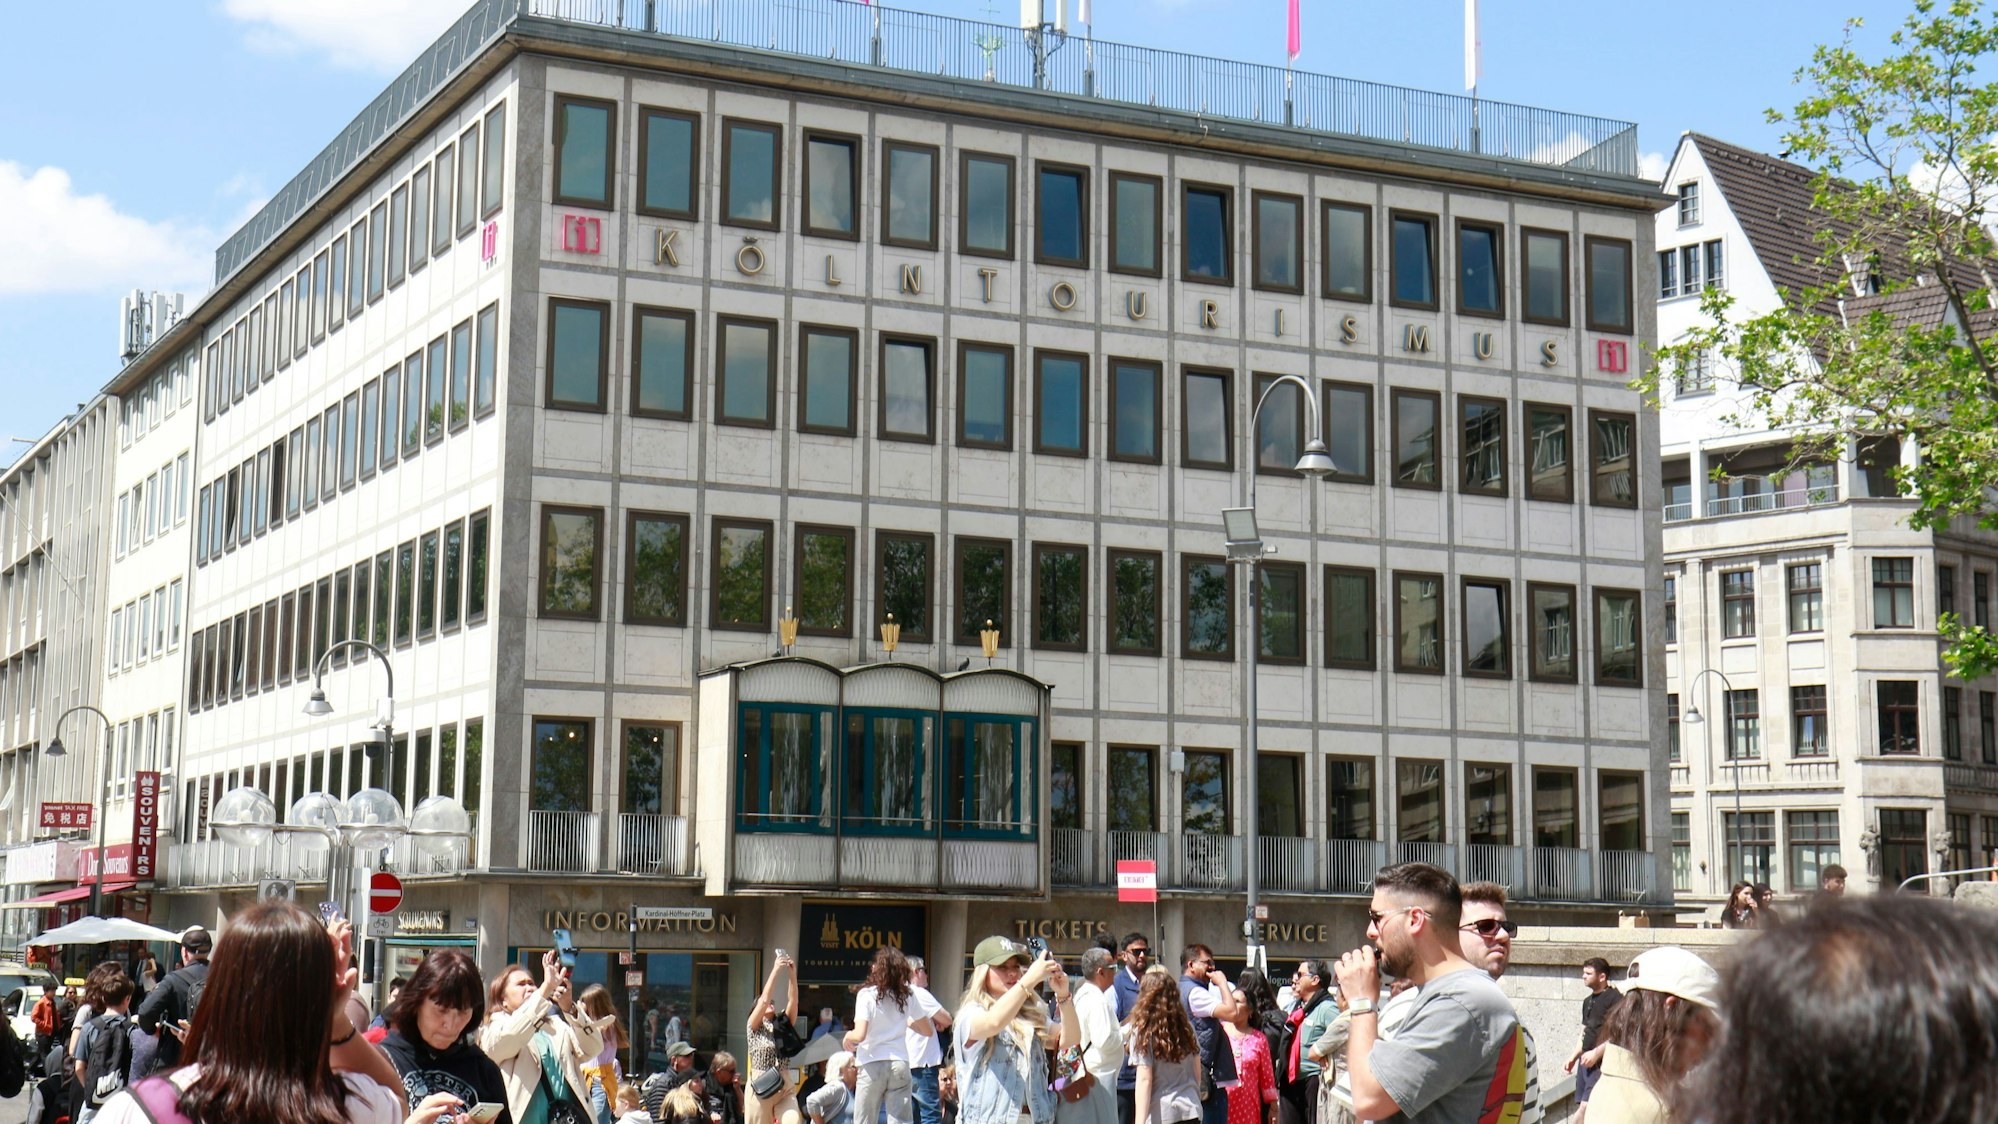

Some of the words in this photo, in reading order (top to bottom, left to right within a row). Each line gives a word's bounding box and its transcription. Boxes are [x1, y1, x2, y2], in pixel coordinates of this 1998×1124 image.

[44, 812, 88, 825] 免税店
[137, 786, 155, 876] SOUVENIRS
[103, 849, 129, 875] Souvenirs
[398, 911, 444, 930] SOUVENIRS
[543, 910, 737, 933] INFORMATION
[1015, 919, 1107, 939] TICKETS
[844, 926, 902, 949] KÖLN
